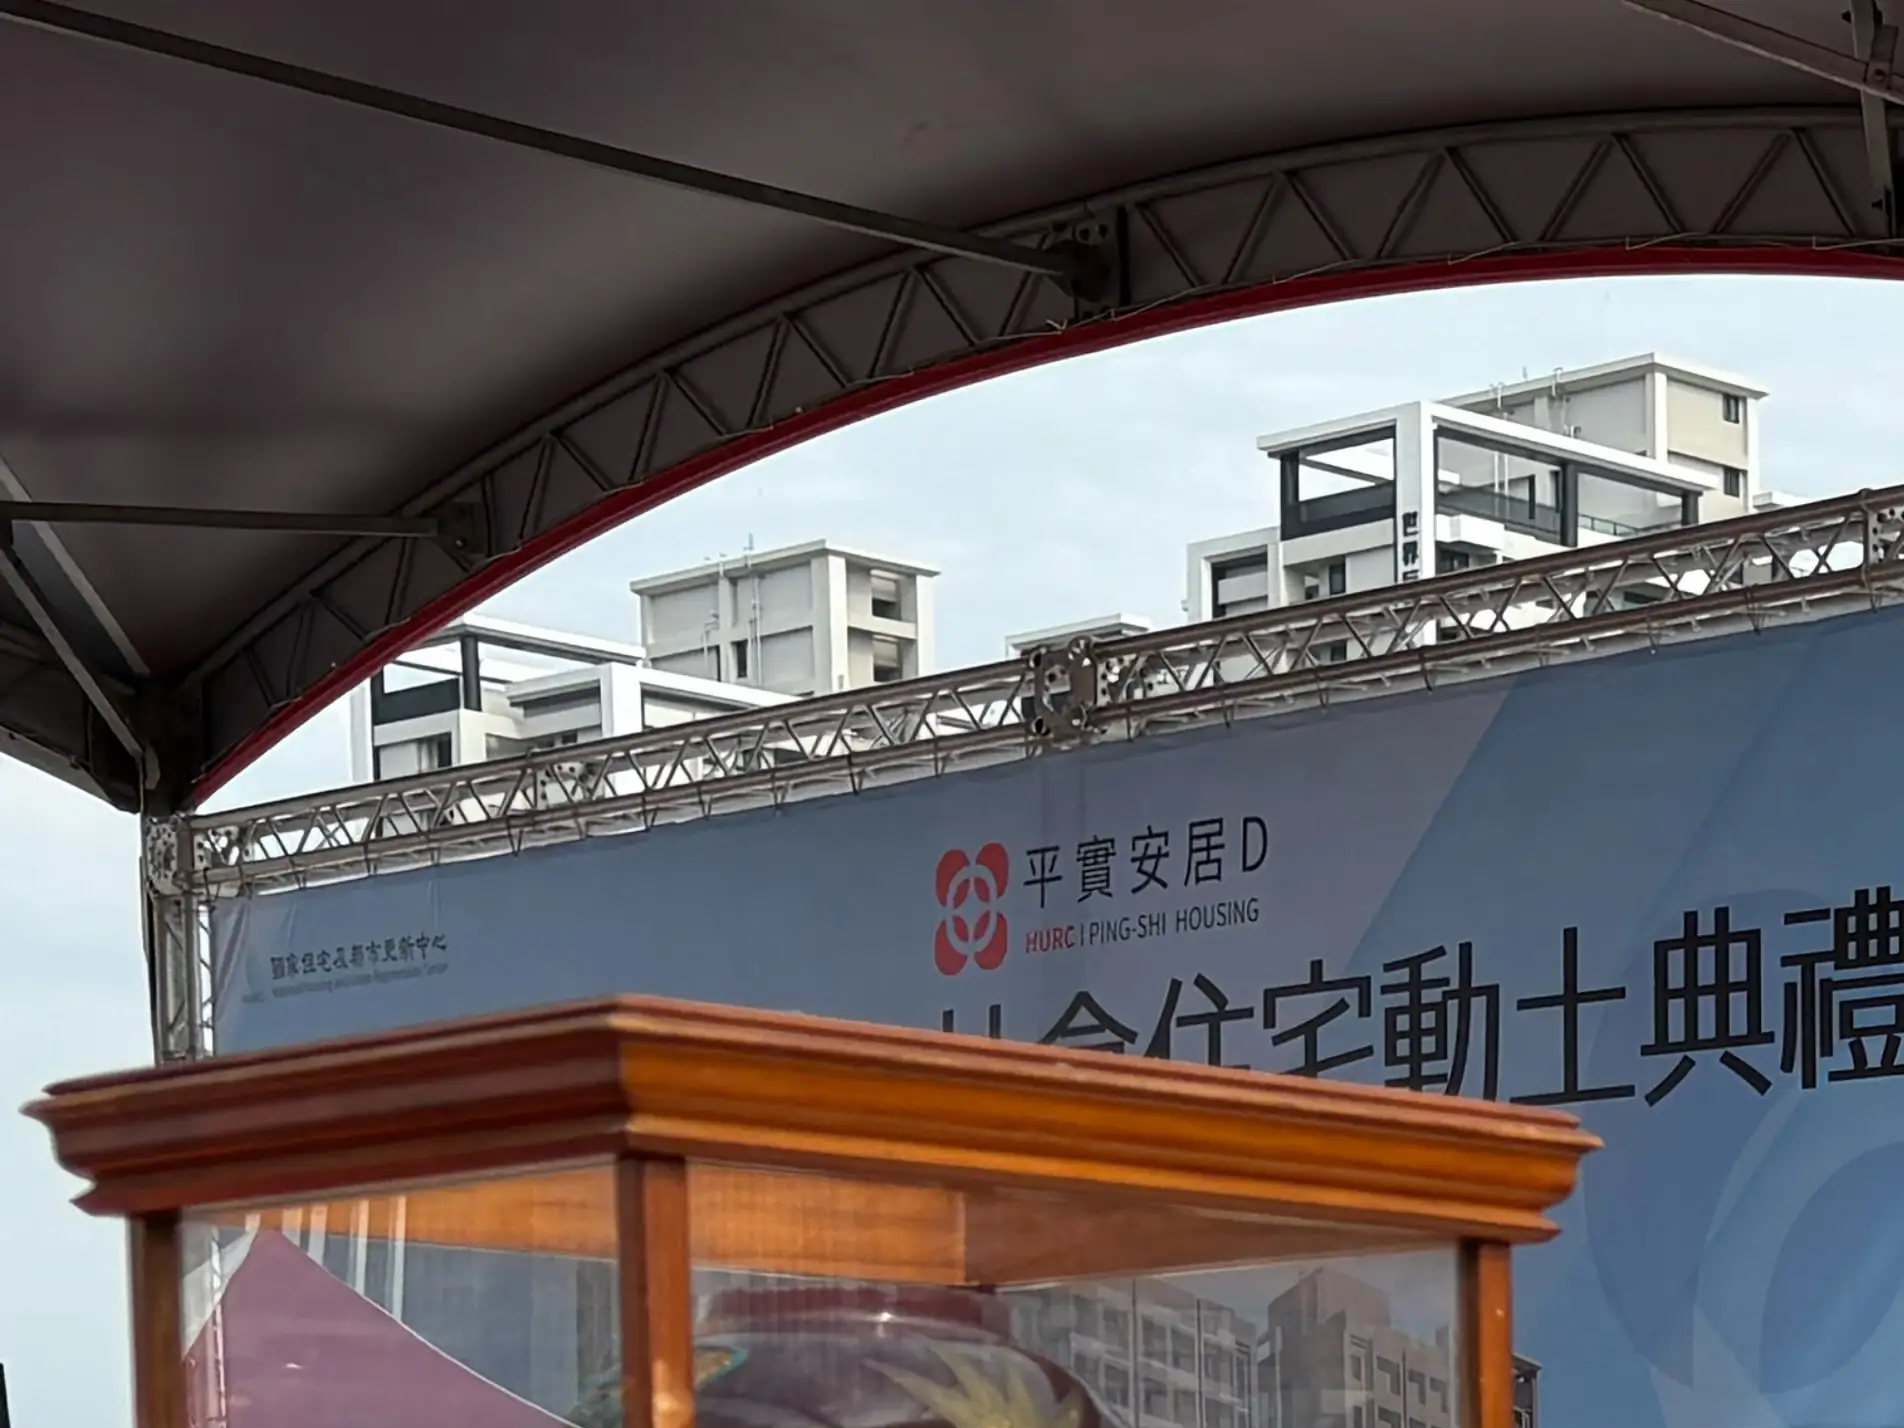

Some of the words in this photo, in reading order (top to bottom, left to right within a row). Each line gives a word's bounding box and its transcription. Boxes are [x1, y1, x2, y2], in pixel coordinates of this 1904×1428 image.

[1023, 816, 1269, 909] 平實安居D
[1024, 925, 1077, 953] HURC
[1089, 913, 1167, 946] PING-SHI
[1175, 898, 1260, 934] HOUSING
